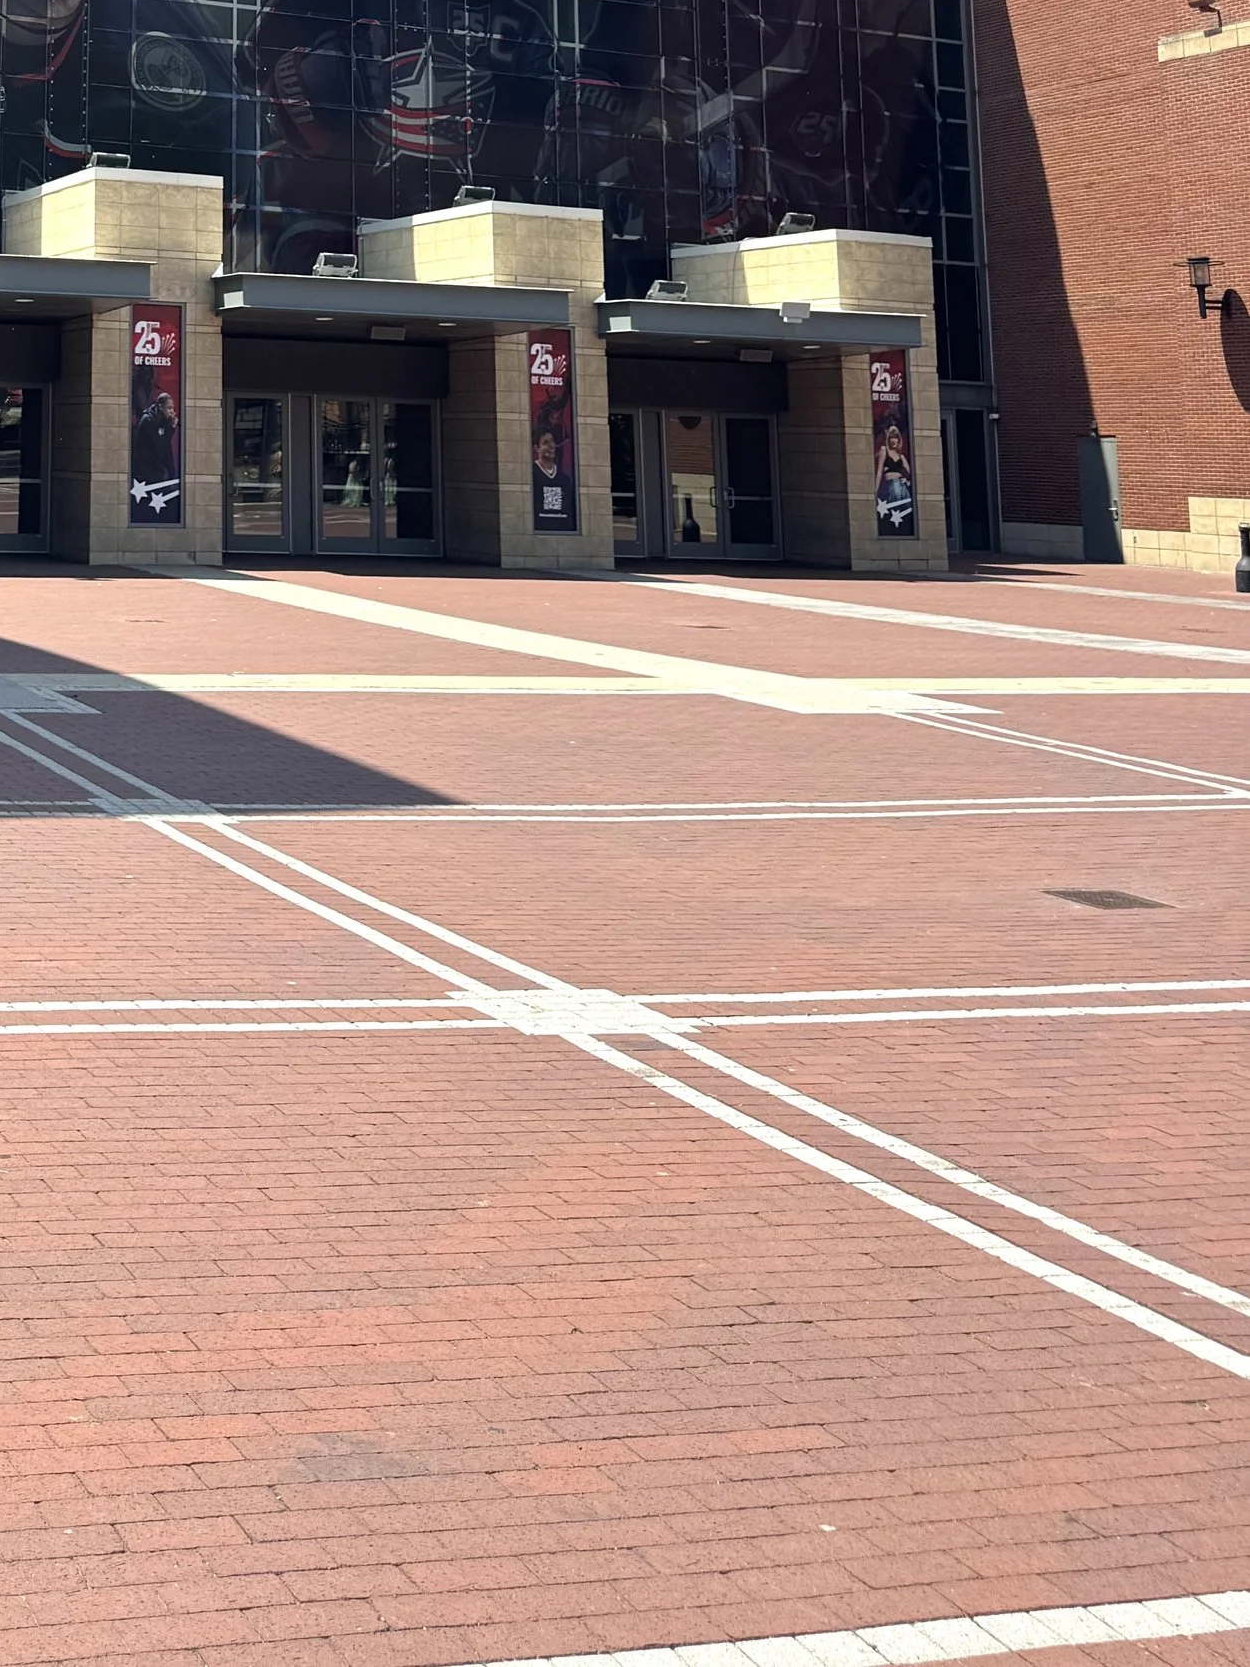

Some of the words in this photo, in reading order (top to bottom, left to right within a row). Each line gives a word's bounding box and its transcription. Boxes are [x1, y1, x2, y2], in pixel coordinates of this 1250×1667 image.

[134, 320, 161, 355] 25
[134, 355, 144, 365] OF
[145, 356, 171, 366] CHEERS
[530, 343, 554, 375] 25
[871, 362, 891, 392] 25
